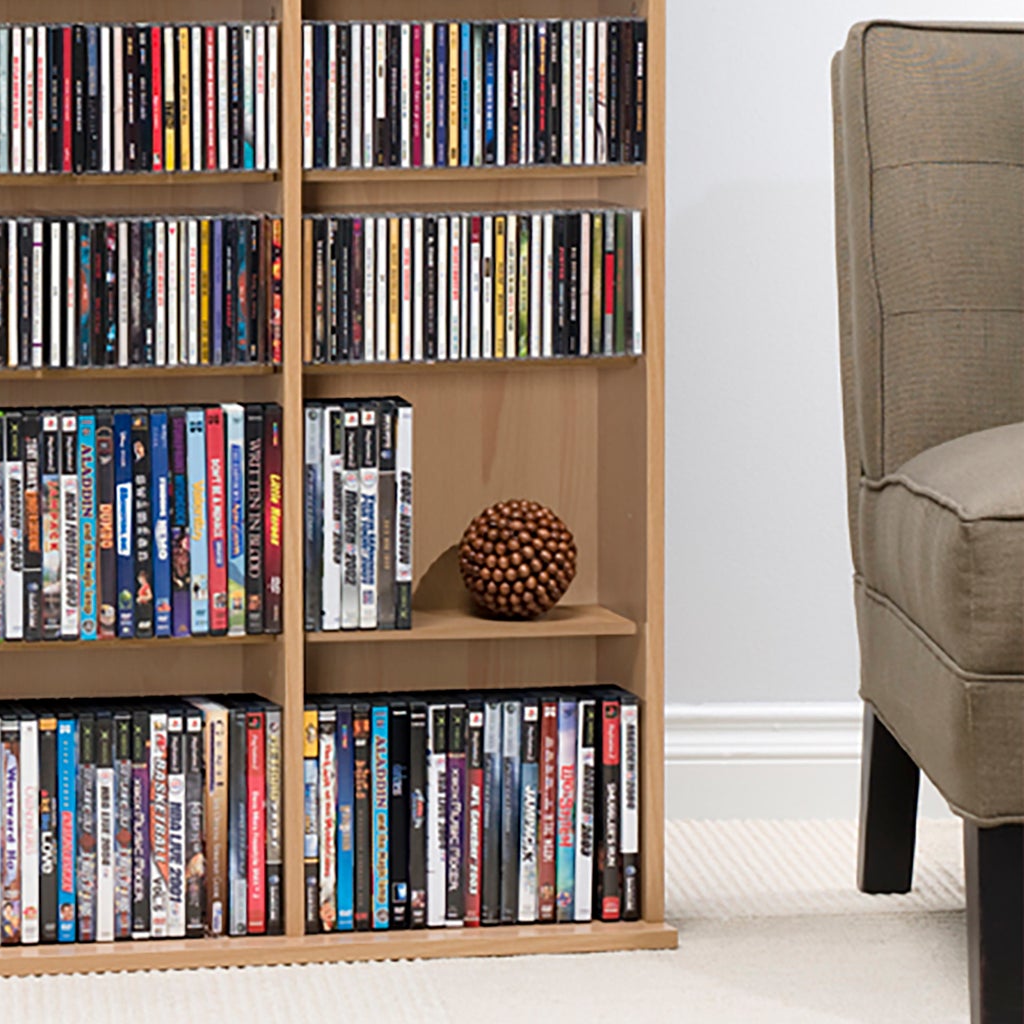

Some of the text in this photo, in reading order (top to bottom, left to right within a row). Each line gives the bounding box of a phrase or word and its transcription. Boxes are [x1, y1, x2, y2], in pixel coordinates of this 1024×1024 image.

[80, 444, 93, 518] ALADDIN
[135, 475, 148, 561] swimfan
[248, 438, 261, 578] WRITTEN IN BLOOD
[270, 474, 281, 503] Little
[376, 736, 388, 808] ALADDIN
[6, 766, 18, 870] Westward Ho
[153, 757, 167, 864] BASKETBALL
[170, 834, 182, 864] LIVE
[170, 867, 182, 903] 2001
